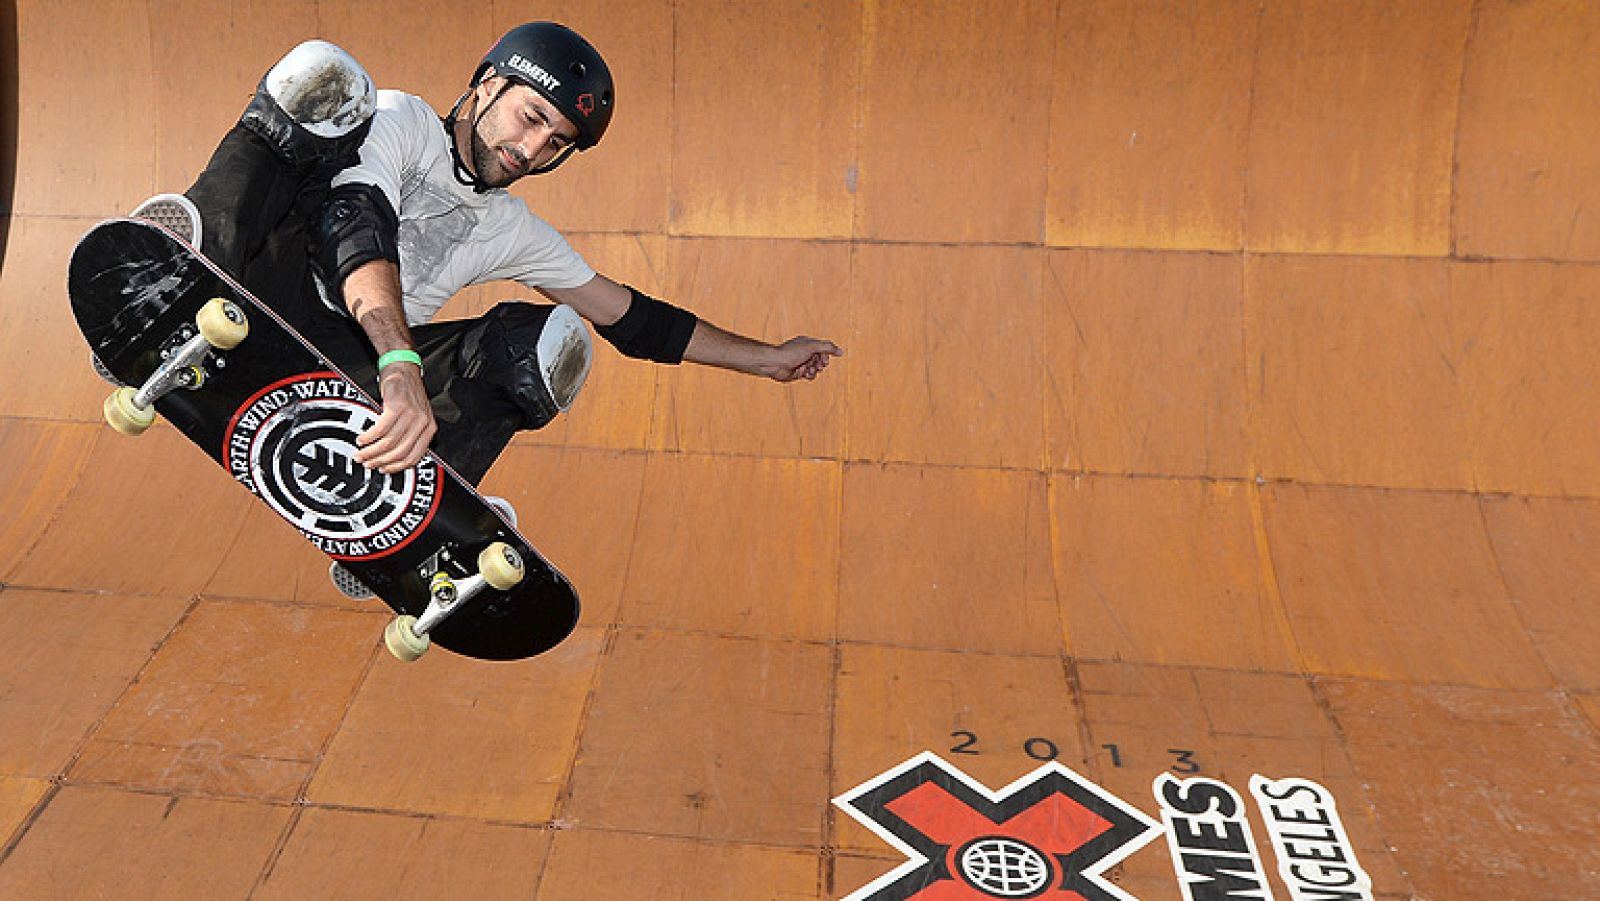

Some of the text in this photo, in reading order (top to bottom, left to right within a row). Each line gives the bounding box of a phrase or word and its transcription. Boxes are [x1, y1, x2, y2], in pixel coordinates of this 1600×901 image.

[508, 53, 562, 91] ELEMENT
[238, 390, 288, 431] WIND
[231, 433, 257, 493] ARTH
[300, 530, 369, 556] WATE
[373, 512, 423, 549] WIND
[950, 730, 1201, 774] 2013
